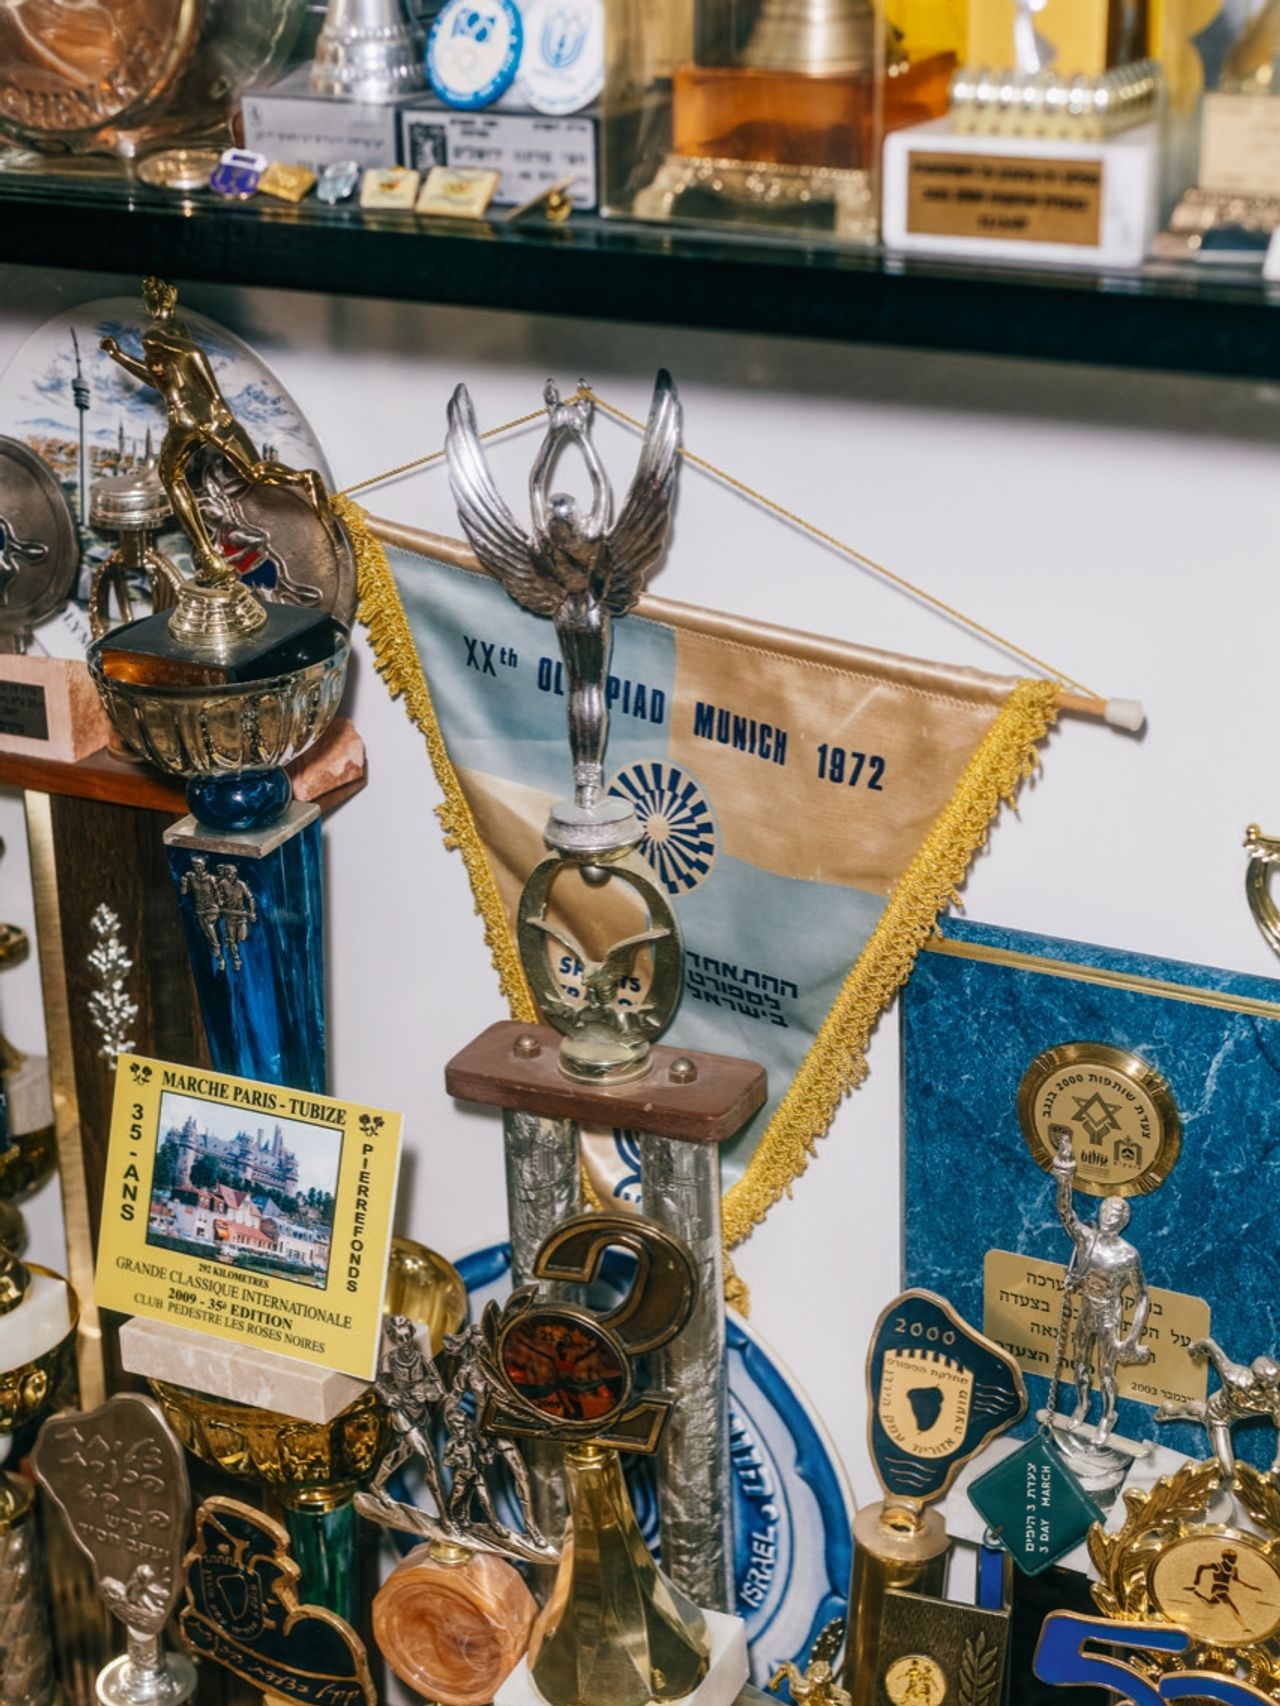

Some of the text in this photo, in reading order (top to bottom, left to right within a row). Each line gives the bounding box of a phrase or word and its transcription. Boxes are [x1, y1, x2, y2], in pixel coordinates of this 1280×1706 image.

[537, 657, 666, 725] OLPIAD
[693, 701, 787, 766] MUNICH
[817, 742, 886, 791] 1972
[162, 1070, 230, 1103] MARCHE
[232, 1085, 277, 1111] PARIS
[288, 1098, 347, 1126] TUBIZE
[346, 1143, 374, 1294] PIERREFONDS
[115, 1256, 352, 1330] GRANDE CLASSIQUE INTERNATIONALE
[197, 1263, 269, 1289] 292 KILOMETRES
[999, 1288, 1050, 1313] בצעדה
[134, 1292, 326, 1354] CLUB PEDESTRE LES ROSES NOIRES
[168, 1287, 197, 1304] 2009
[230, 1304, 294, 1331] EDITION
[893, 1317, 956, 1346] 2000
[1131, 1382, 1158, 1396] 2003
[1026, 1462, 1037, 1500] צעדת
[1039, 1465, 1051, 1554] 3 DAY MARCH
[739, 1525, 776, 1609] ISRAEL
